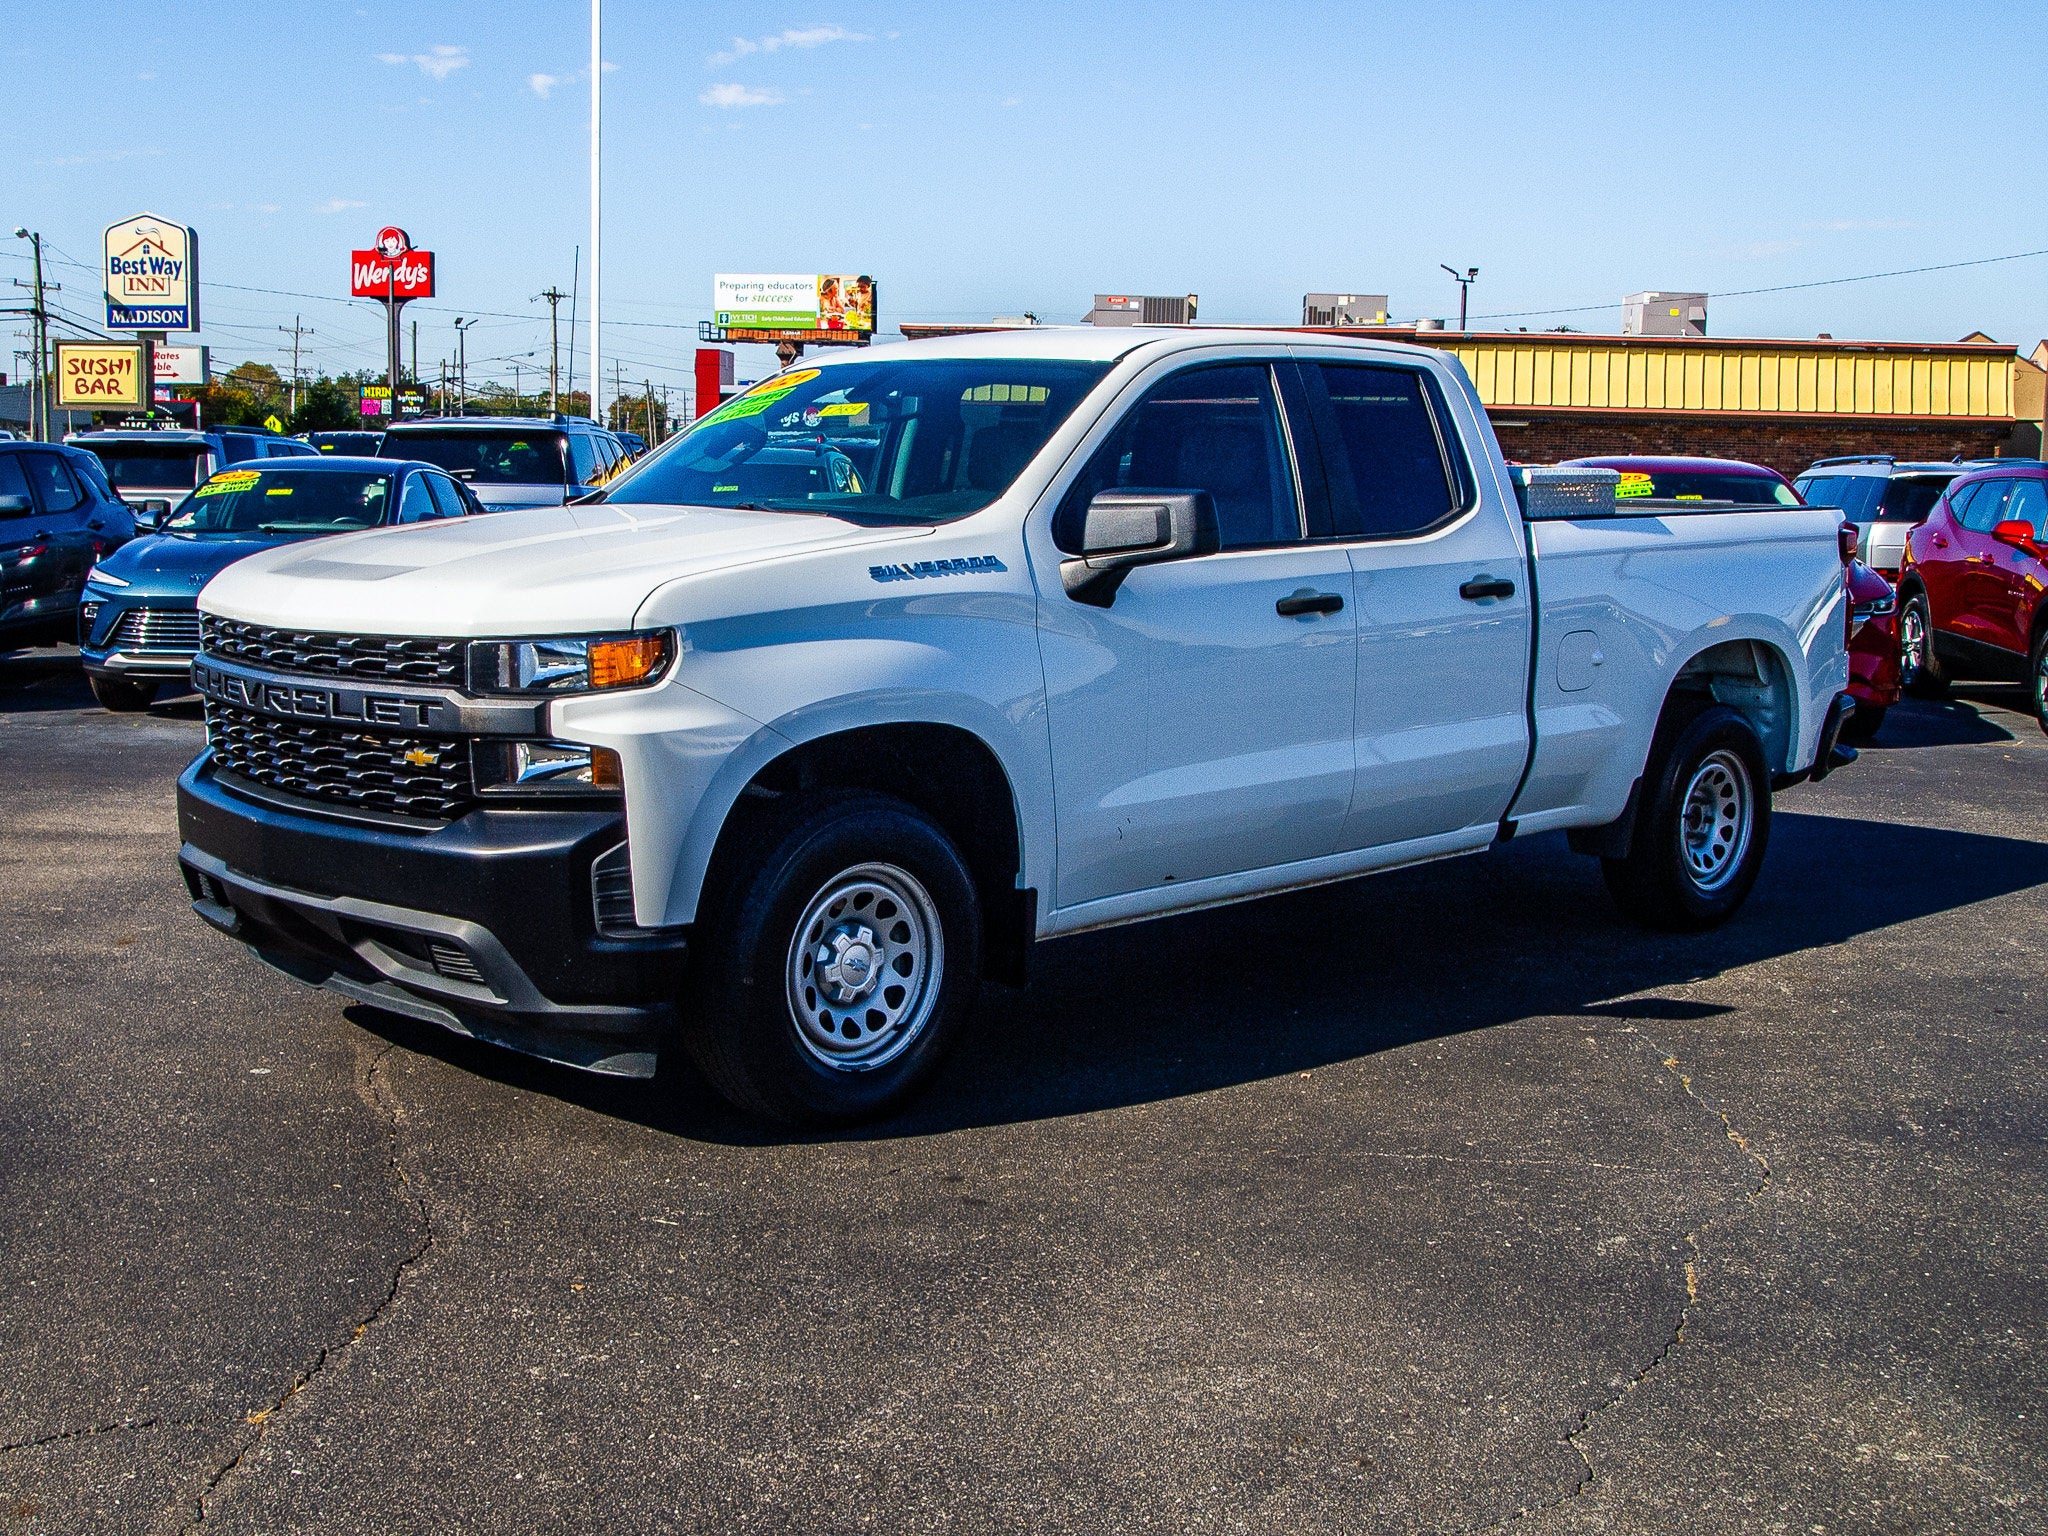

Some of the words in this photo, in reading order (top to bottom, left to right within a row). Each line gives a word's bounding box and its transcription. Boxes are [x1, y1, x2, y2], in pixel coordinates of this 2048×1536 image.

[110, 256, 146, 275] Best
[148, 256, 182, 281] Way
[353, 257, 428, 290] Wendy's
[128, 277, 165, 291] INN
[719, 281, 764, 292] Preparing
[767, 281, 814, 290] educators
[735, 294, 749, 303] for
[751, 295, 794, 303] success
[111, 309, 184, 324] MADISON
[154, 351, 180, 360] Rates
[67, 358, 132, 376] SUSHI
[75, 377, 123, 395] BAR
[868, 555, 998, 578] SILVERADO
[193, 663, 444, 728] CHEVROLET
